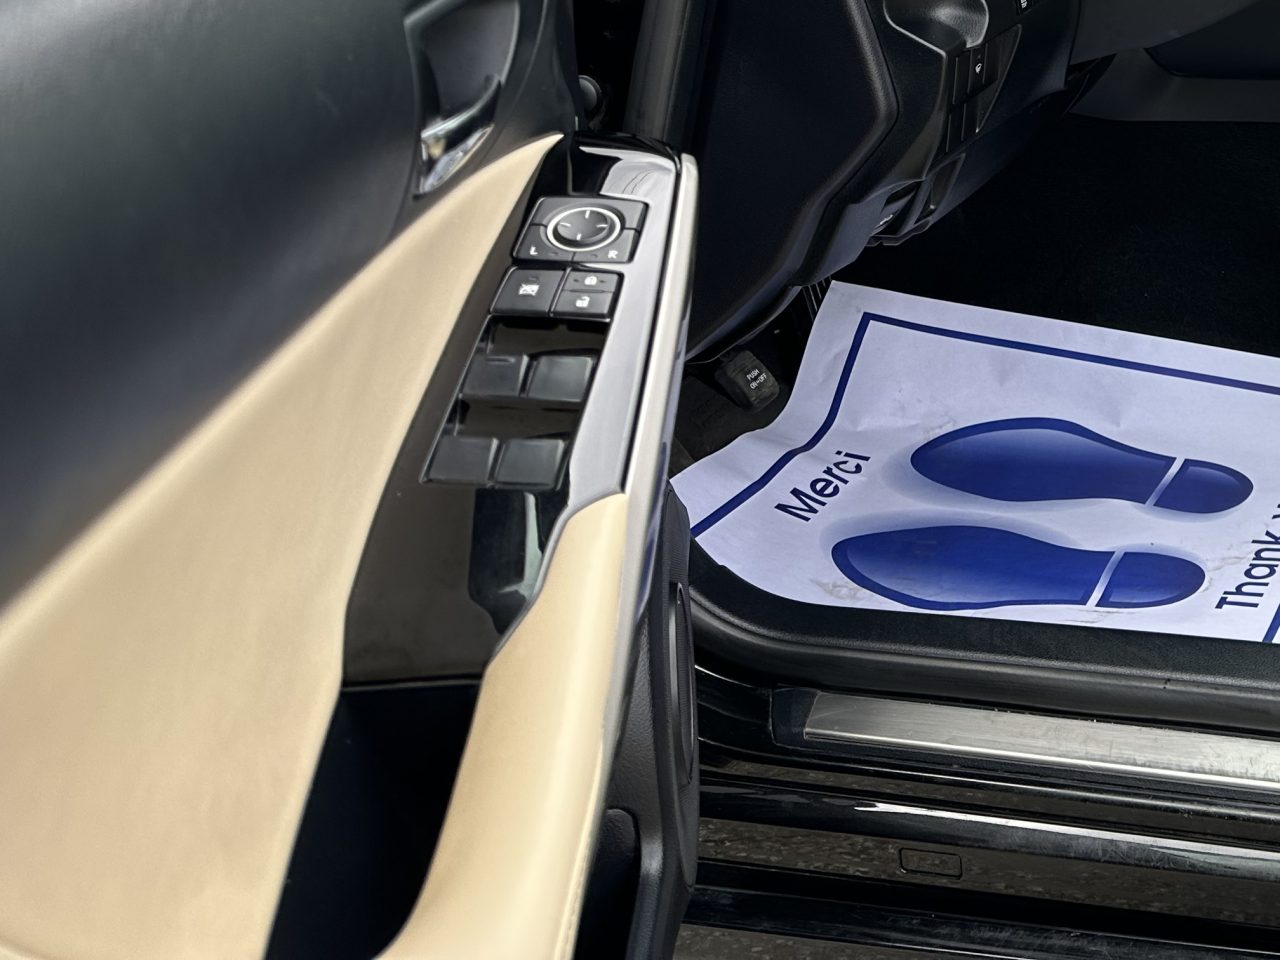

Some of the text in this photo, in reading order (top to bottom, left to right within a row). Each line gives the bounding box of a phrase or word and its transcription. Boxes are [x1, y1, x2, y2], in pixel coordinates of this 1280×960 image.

[529, 246, 538, 256] L
[607, 249, 618, 259] R
[774, 450, 871, 522] Merci
